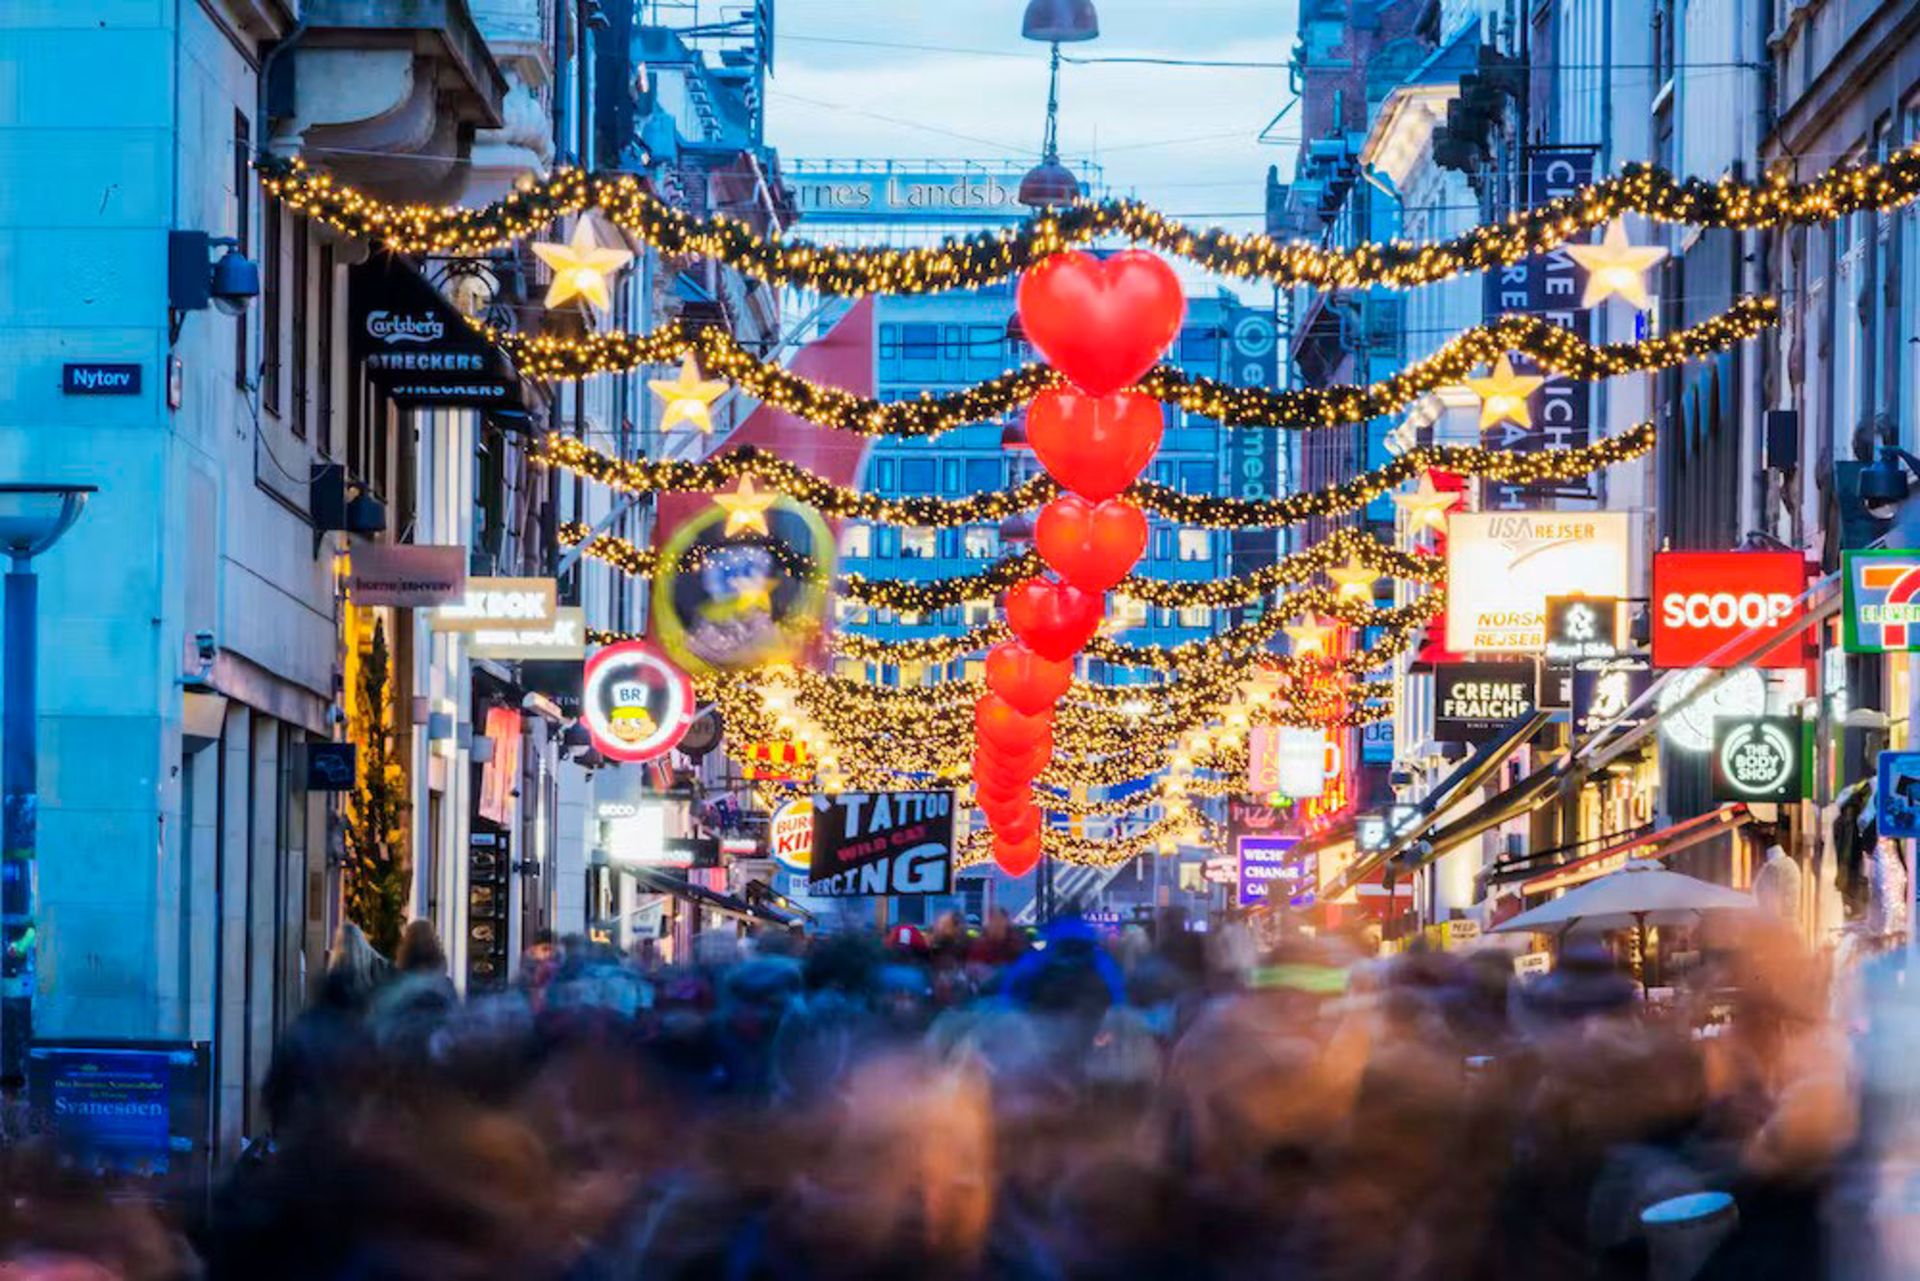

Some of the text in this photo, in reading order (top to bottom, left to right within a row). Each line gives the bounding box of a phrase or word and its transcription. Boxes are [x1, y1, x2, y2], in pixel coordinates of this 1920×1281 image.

[366, 310, 444, 340] Carlsberg
[367, 352, 484, 370] STRECKERS
[73, 368, 130, 389] Nytorv
[1488, 517, 1595, 538] USA REJSER
[1663, 592, 1793, 628] SCOOP
[619, 687, 640, 701] BR
[1452, 683, 1522, 700] CREME
[1744, 744, 1770, 756] THE
[1735, 755, 1779, 768] BODY
[1738, 767, 1777, 781] SHOP
[835, 793, 949, 839] TATTOO
[1233, 804, 1289, 823] PIZZA
